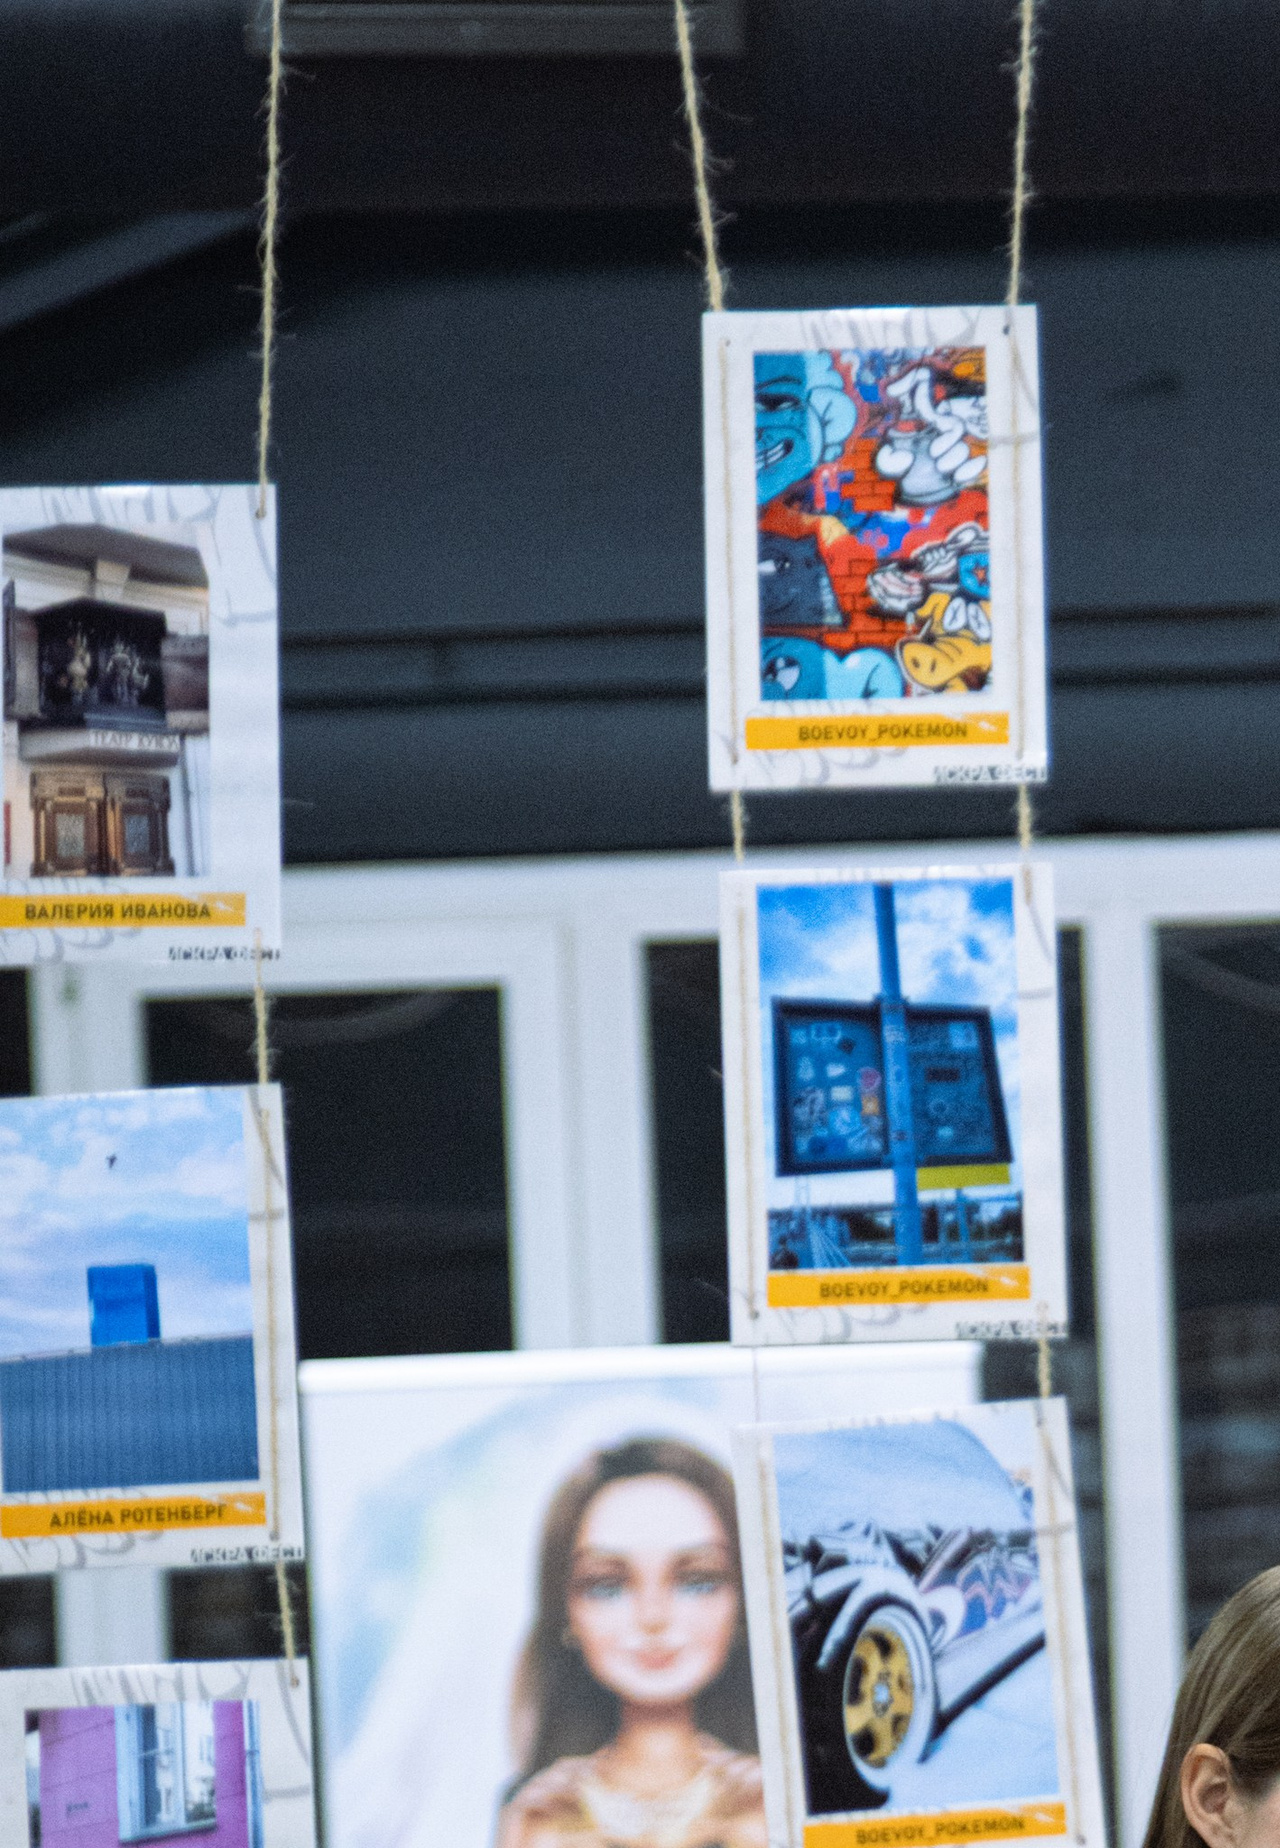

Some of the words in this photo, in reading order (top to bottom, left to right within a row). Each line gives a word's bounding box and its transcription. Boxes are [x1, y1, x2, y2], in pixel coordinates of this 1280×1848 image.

[798, 722, 968, 742] BOEVOY_POKEMON
[25, 904, 115, 921] ВАЛЕРИЯ
[120, 902, 212, 920] ИВАНОВА
[819, 1278, 989, 1298] BOEVOY_POKEMON
[50, 1508, 115, 1528] АЛЁНА
[120, 1503, 228, 1523] РОТЕНБЕРГ
[855, 1815, 1025, 1845] BOEVOY_POKEMON
